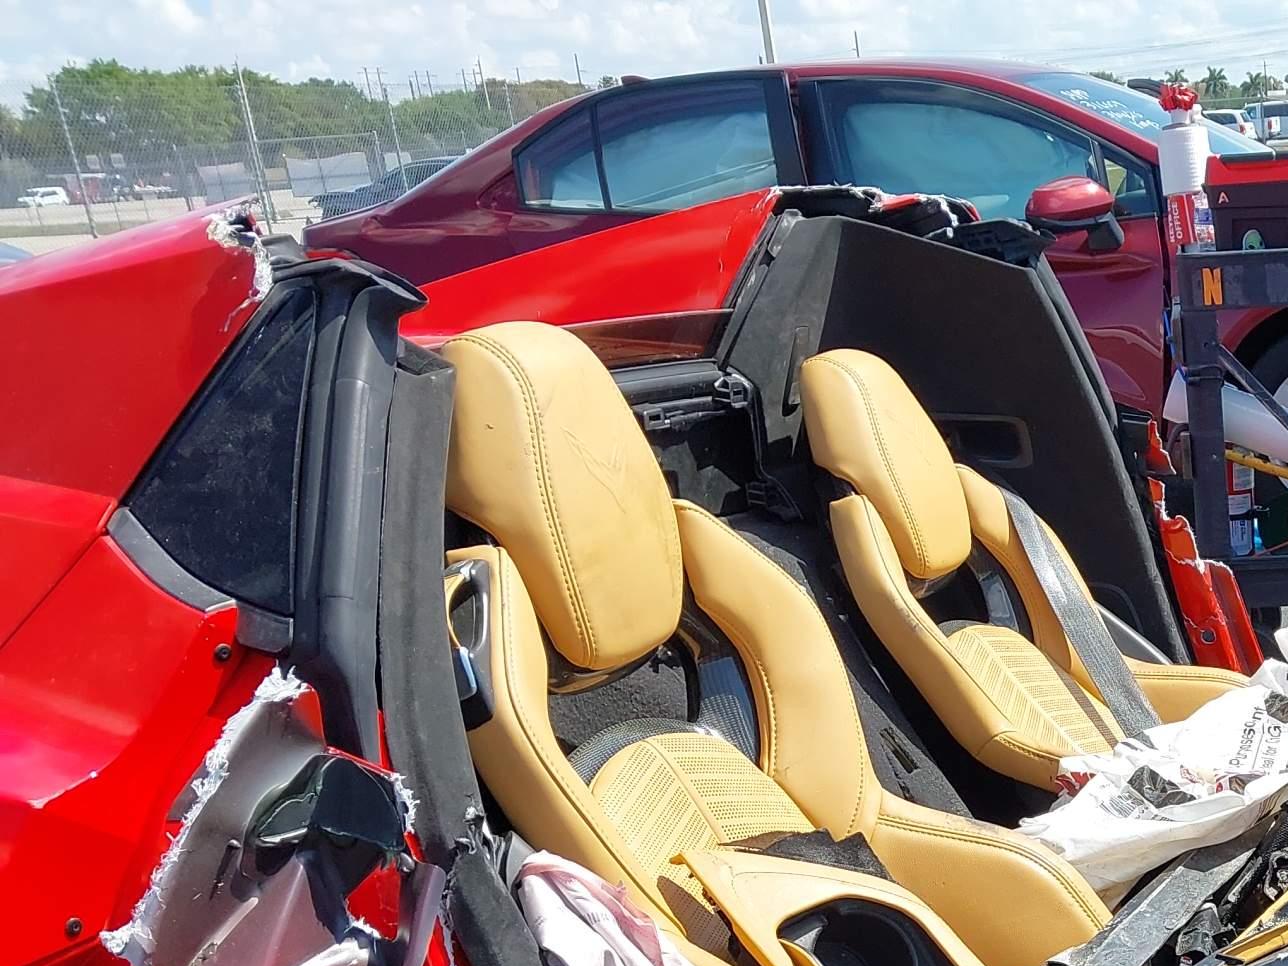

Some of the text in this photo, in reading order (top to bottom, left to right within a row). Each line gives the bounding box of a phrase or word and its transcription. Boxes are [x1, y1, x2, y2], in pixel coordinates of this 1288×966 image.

[1218, 191, 1229, 204] A
[1172, 201, 1183, 239] OFFICE
[1202, 267, 1224, 306] N
